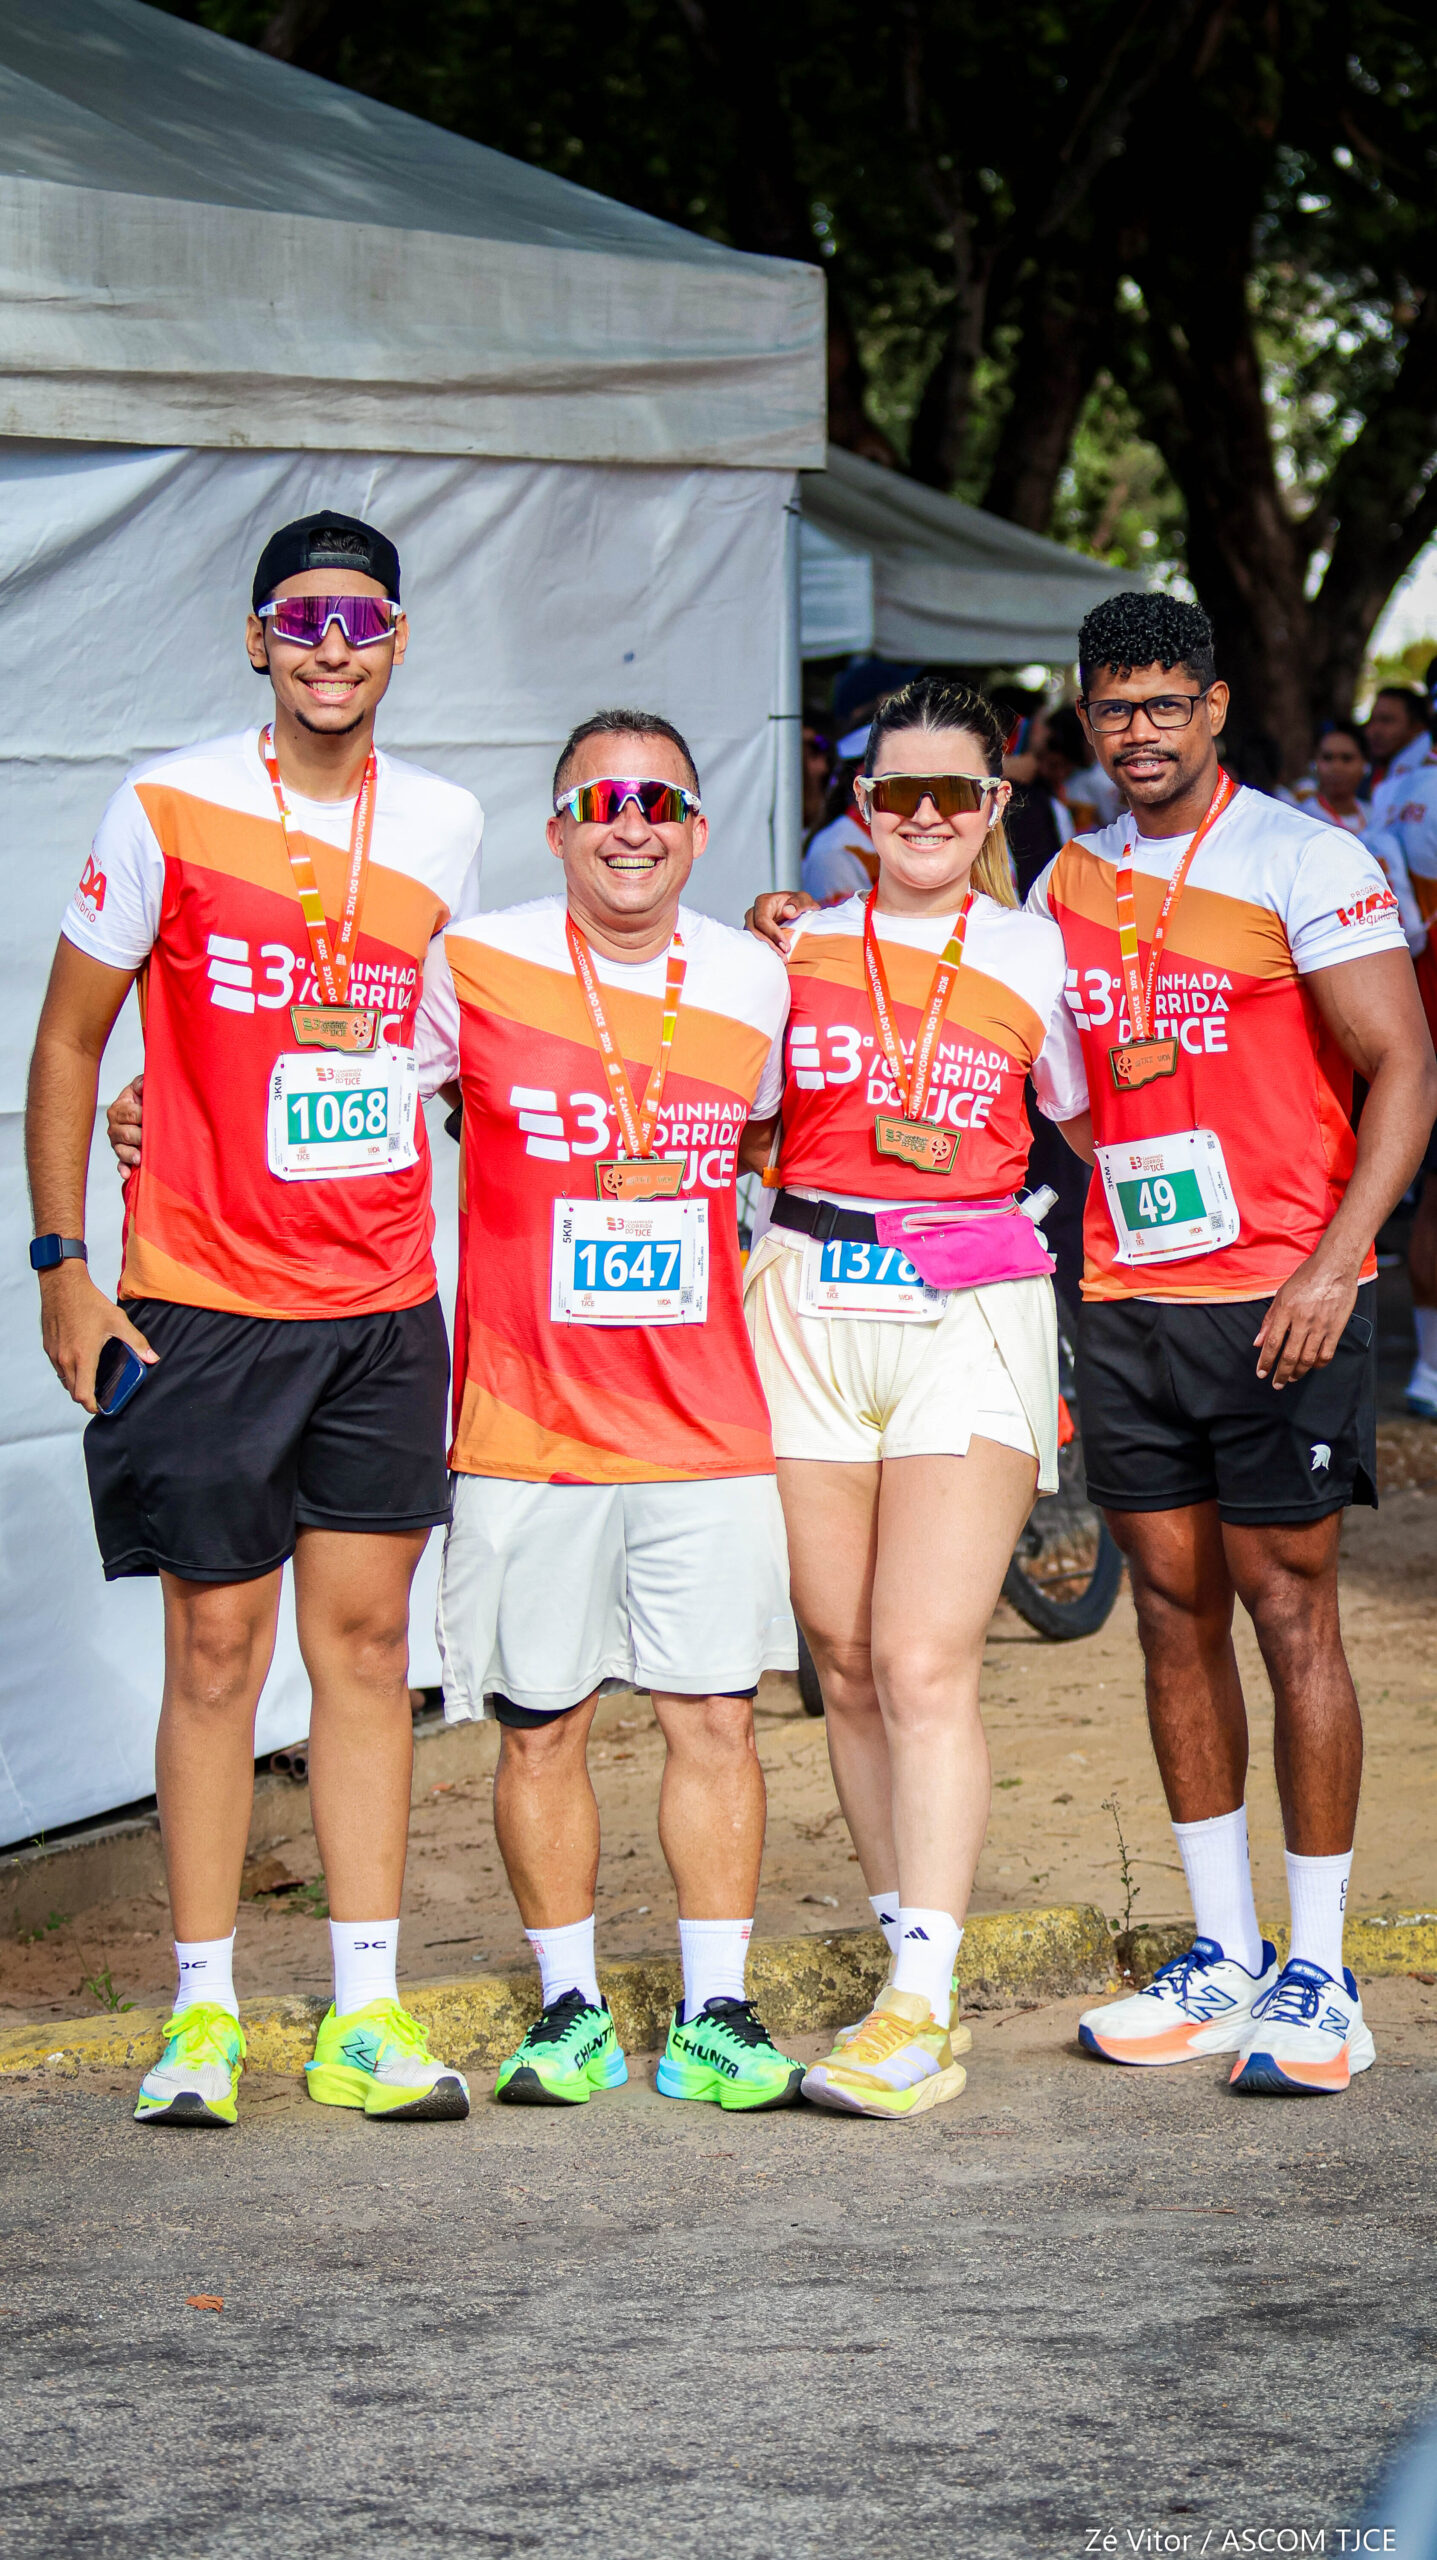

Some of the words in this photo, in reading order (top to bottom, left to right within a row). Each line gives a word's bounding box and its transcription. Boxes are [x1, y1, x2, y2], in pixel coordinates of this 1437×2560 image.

[79, 854, 107, 912] DA
[341, 921, 353, 943] 2026
[316, 938, 328, 960] 2026
[257, 943, 306, 1009] 3ª
[1129, 969, 1138, 991] 2026
[328, 987, 338, 1002] DO
[927, 1017, 937, 1031] DO
[937, 976, 949, 994] 2026
[1084, 968, 1121, 1026] 3ª
[1156, 973, 1233, 991] INHADA
[588, 993, 599, 1007] DO
[600, 1032, 613, 1053] 2026
[880, 1017, 890, 1031] DO
[1118, 1019, 1133, 1043] D
[826, 1025, 874, 1084] 3ª
[274, 1076, 282, 1101] 3KM
[291, 1091, 387, 1140] 1068
[636, 1103, 747, 1122] MINHADA
[1104, 1166, 1115, 1190] 3KM
[1139, 1178, 1177, 1223] 49
[563, 1219, 572, 1244] 5KM
[635, 1229, 652, 1237] TJCE
[578, 1243, 680, 1288] 1647
[672, 2032, 739, 2079] CHUNTA
